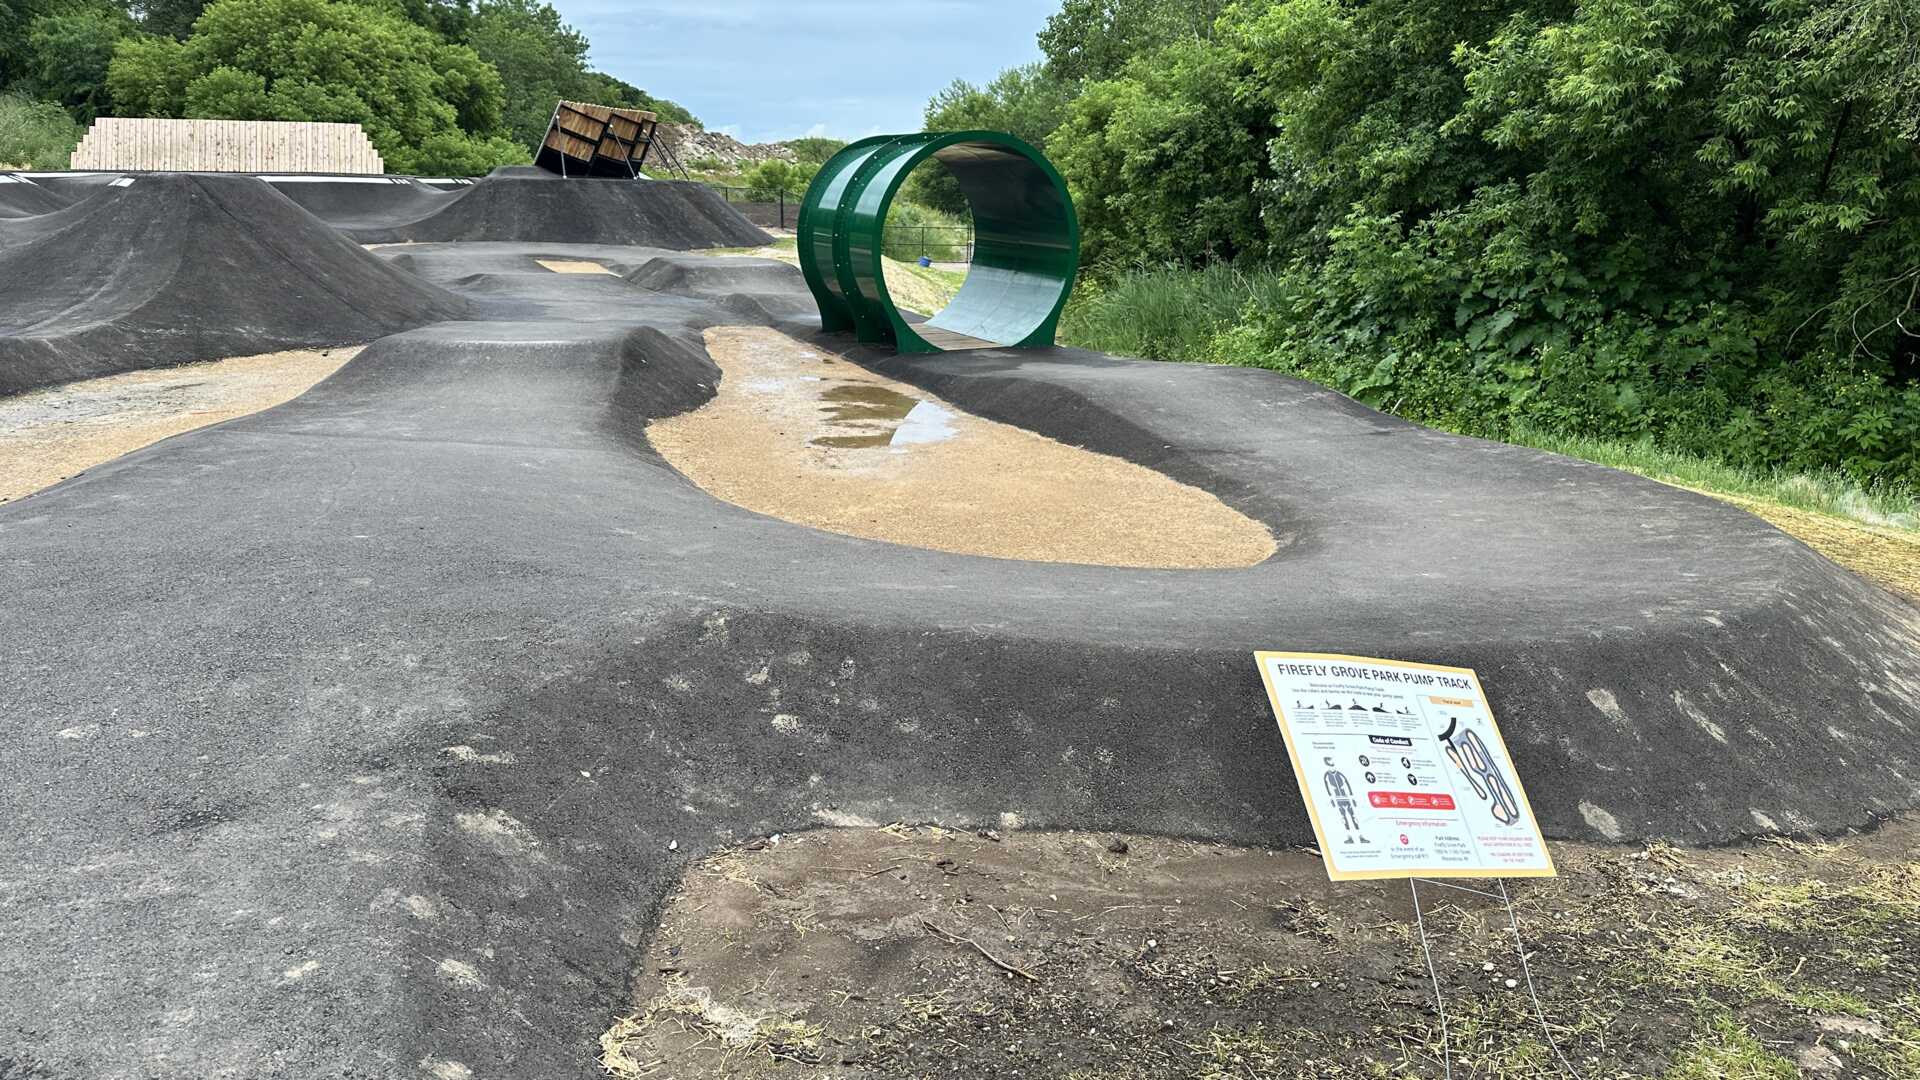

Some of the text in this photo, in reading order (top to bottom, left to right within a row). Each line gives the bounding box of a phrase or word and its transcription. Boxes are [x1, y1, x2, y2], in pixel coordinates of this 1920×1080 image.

[1277, 663, 1472, 690] FIREFLY GROVE PARK PUMP TRACK
